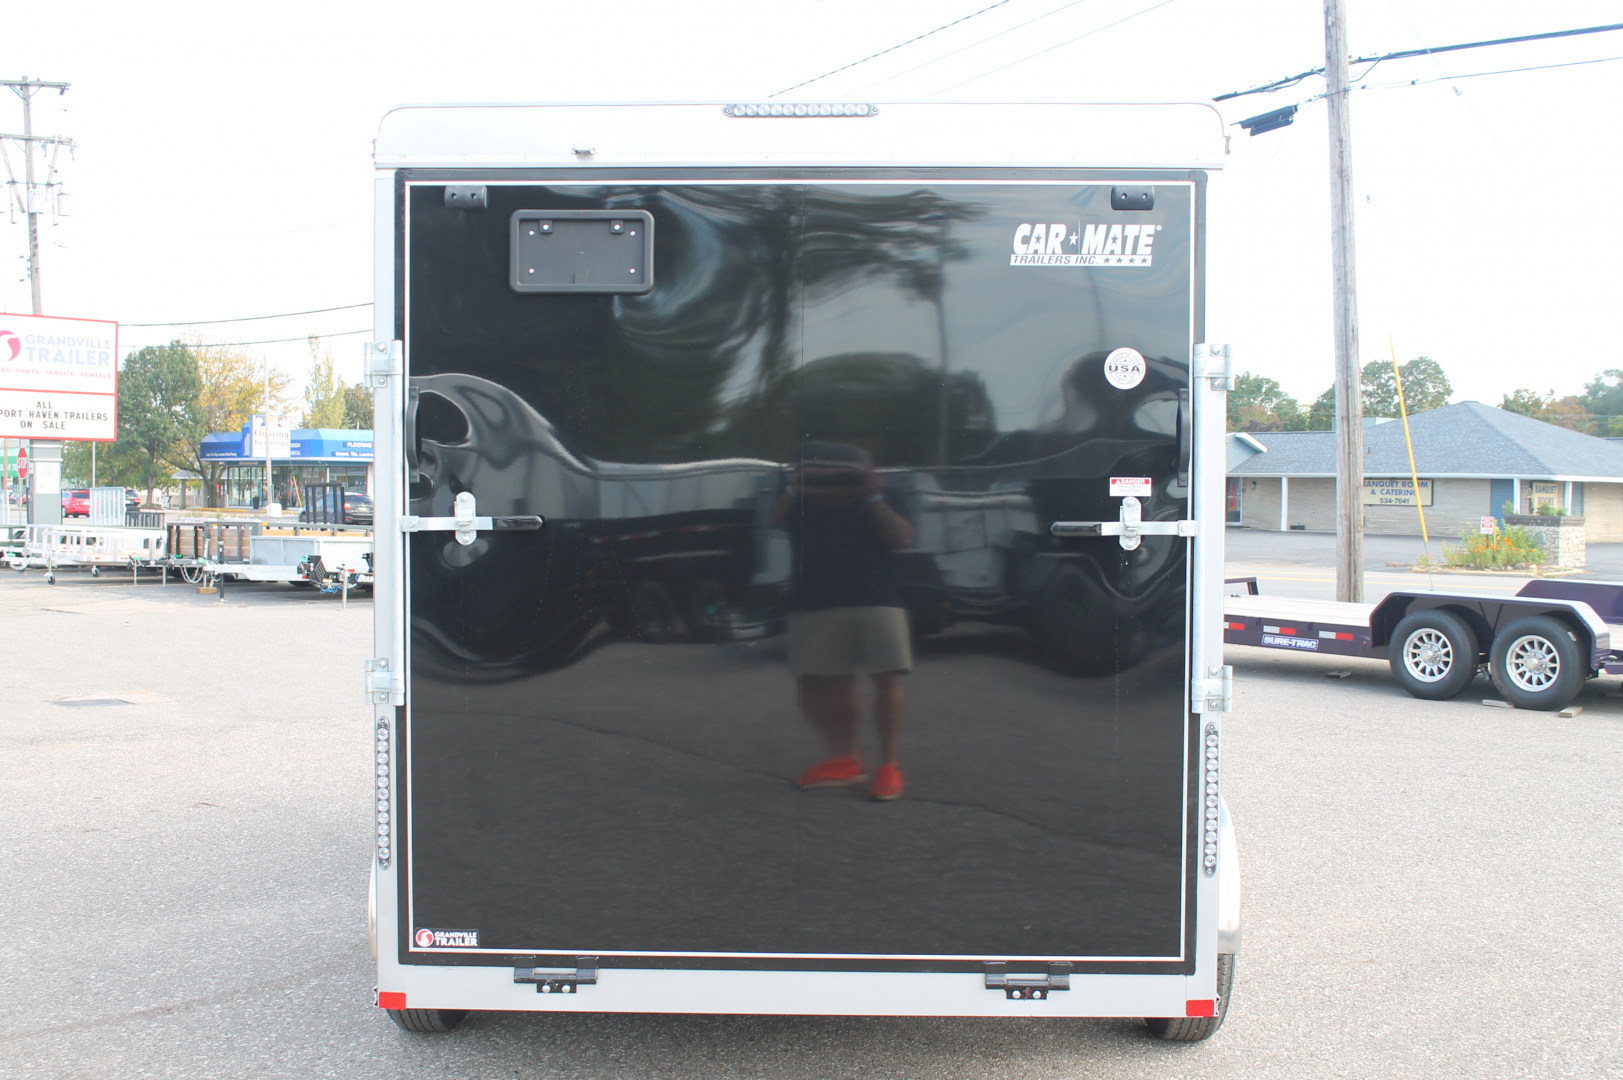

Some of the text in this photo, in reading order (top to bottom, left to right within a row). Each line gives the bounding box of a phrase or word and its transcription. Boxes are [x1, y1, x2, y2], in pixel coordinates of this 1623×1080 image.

[1013, 223, 1156, 255] CAR MATE
[1013, 255, 1099, 265] TRAILERS INC.
[25, 333, 112, 350] GRANDVILLE
[25, 346, 111, 367] TRAILER
[1108, 364, 1140, 373] USA
[45, 369, 75, 377] SERVICE
[80, 371, 112, 379] RENTALS
[36, 400, 54, 409] ALL
[0, 409, 108, 421] PORT HAVEN TRAILERS
[20, 420, 66, 430] ON SALE
[254, 429, 289, 439] Flooring
[18, 457, 28, 469] STOP
[1363, 480, 1399, 488] BANQUET
[1263, 636, 1317, 649] SURE-TRAC
[434, 937, 478, 947] TRAILER
